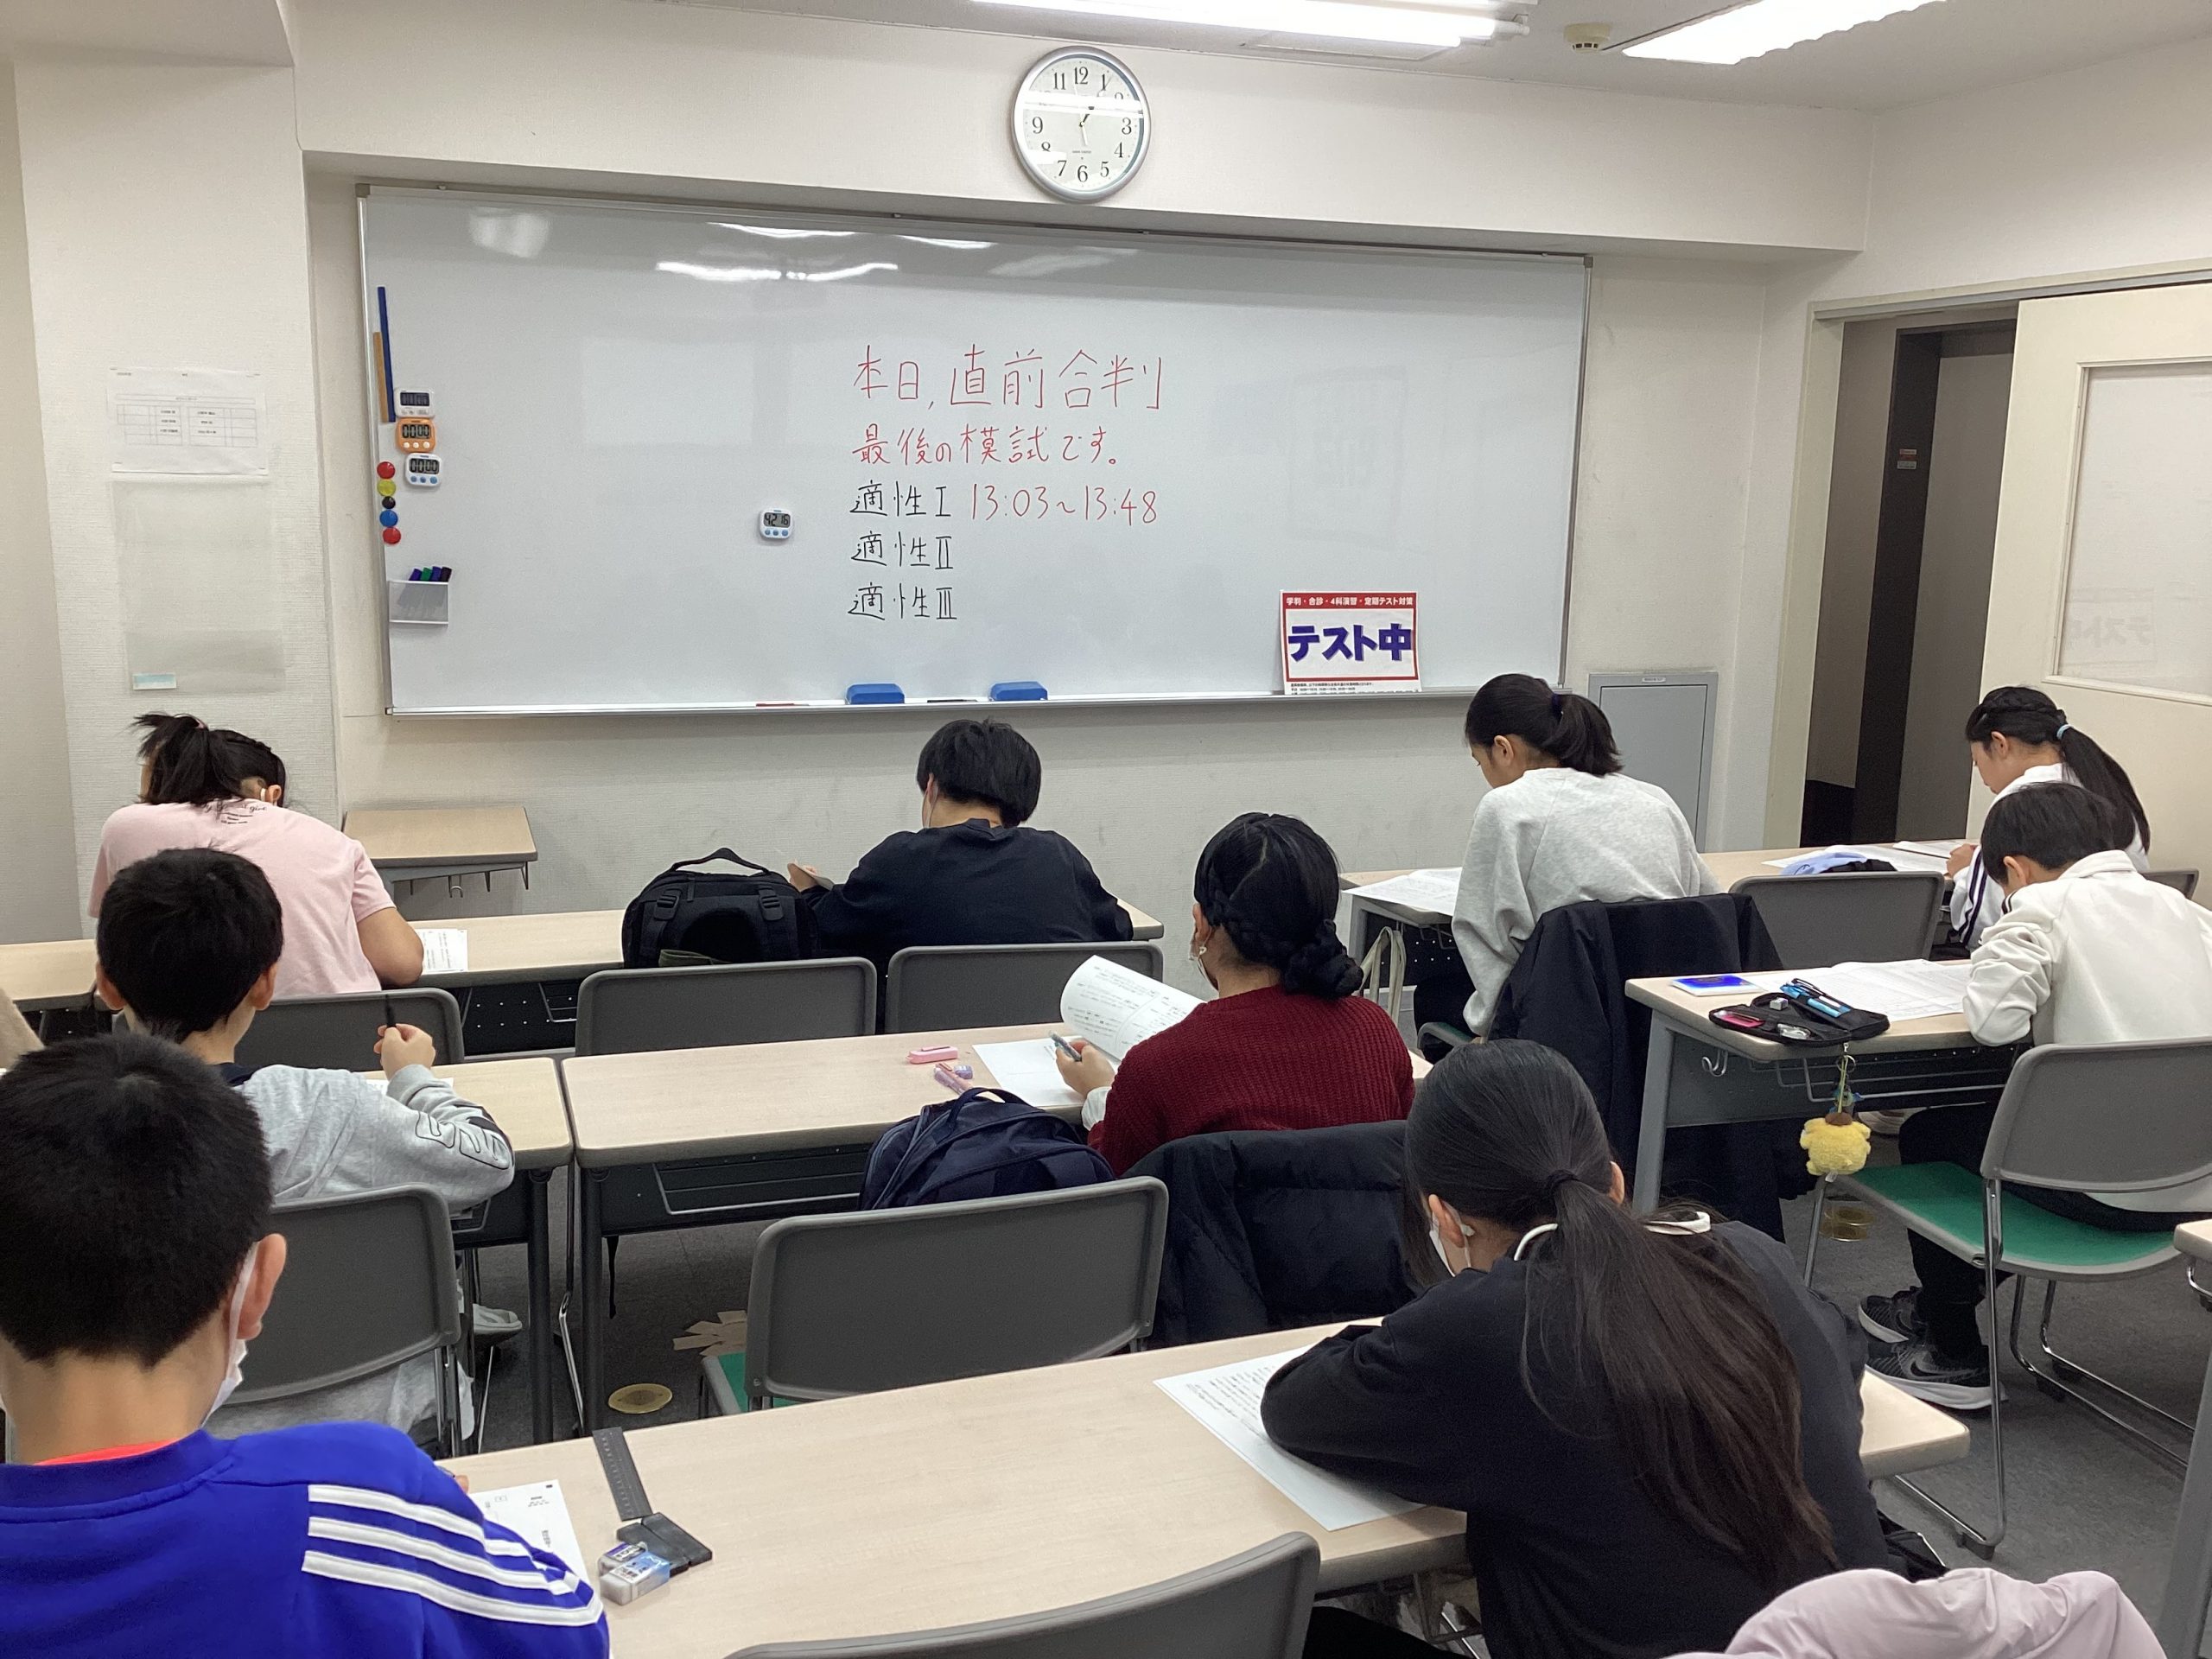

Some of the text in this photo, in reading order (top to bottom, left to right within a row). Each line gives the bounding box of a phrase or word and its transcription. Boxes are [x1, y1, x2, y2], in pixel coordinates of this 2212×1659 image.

[1053, 72, 1066, 91] 11
[1074, 67, 1089, 85] 12
[1101, 73, 1107, 92] 1
[1032, 116, 1044, 134] 9
[1121, 117, 1132, 135] 3
[1114, 142, 1124, 158] 4
[1057, 160, 1067, 176] 7
[1077, 165, 1089, 182] 6
[1100, 161, 1109, 178] 5
[852, 423, 1117, 466] 最後の模試です。
[1287, 623, 1413, 662] テスト中
